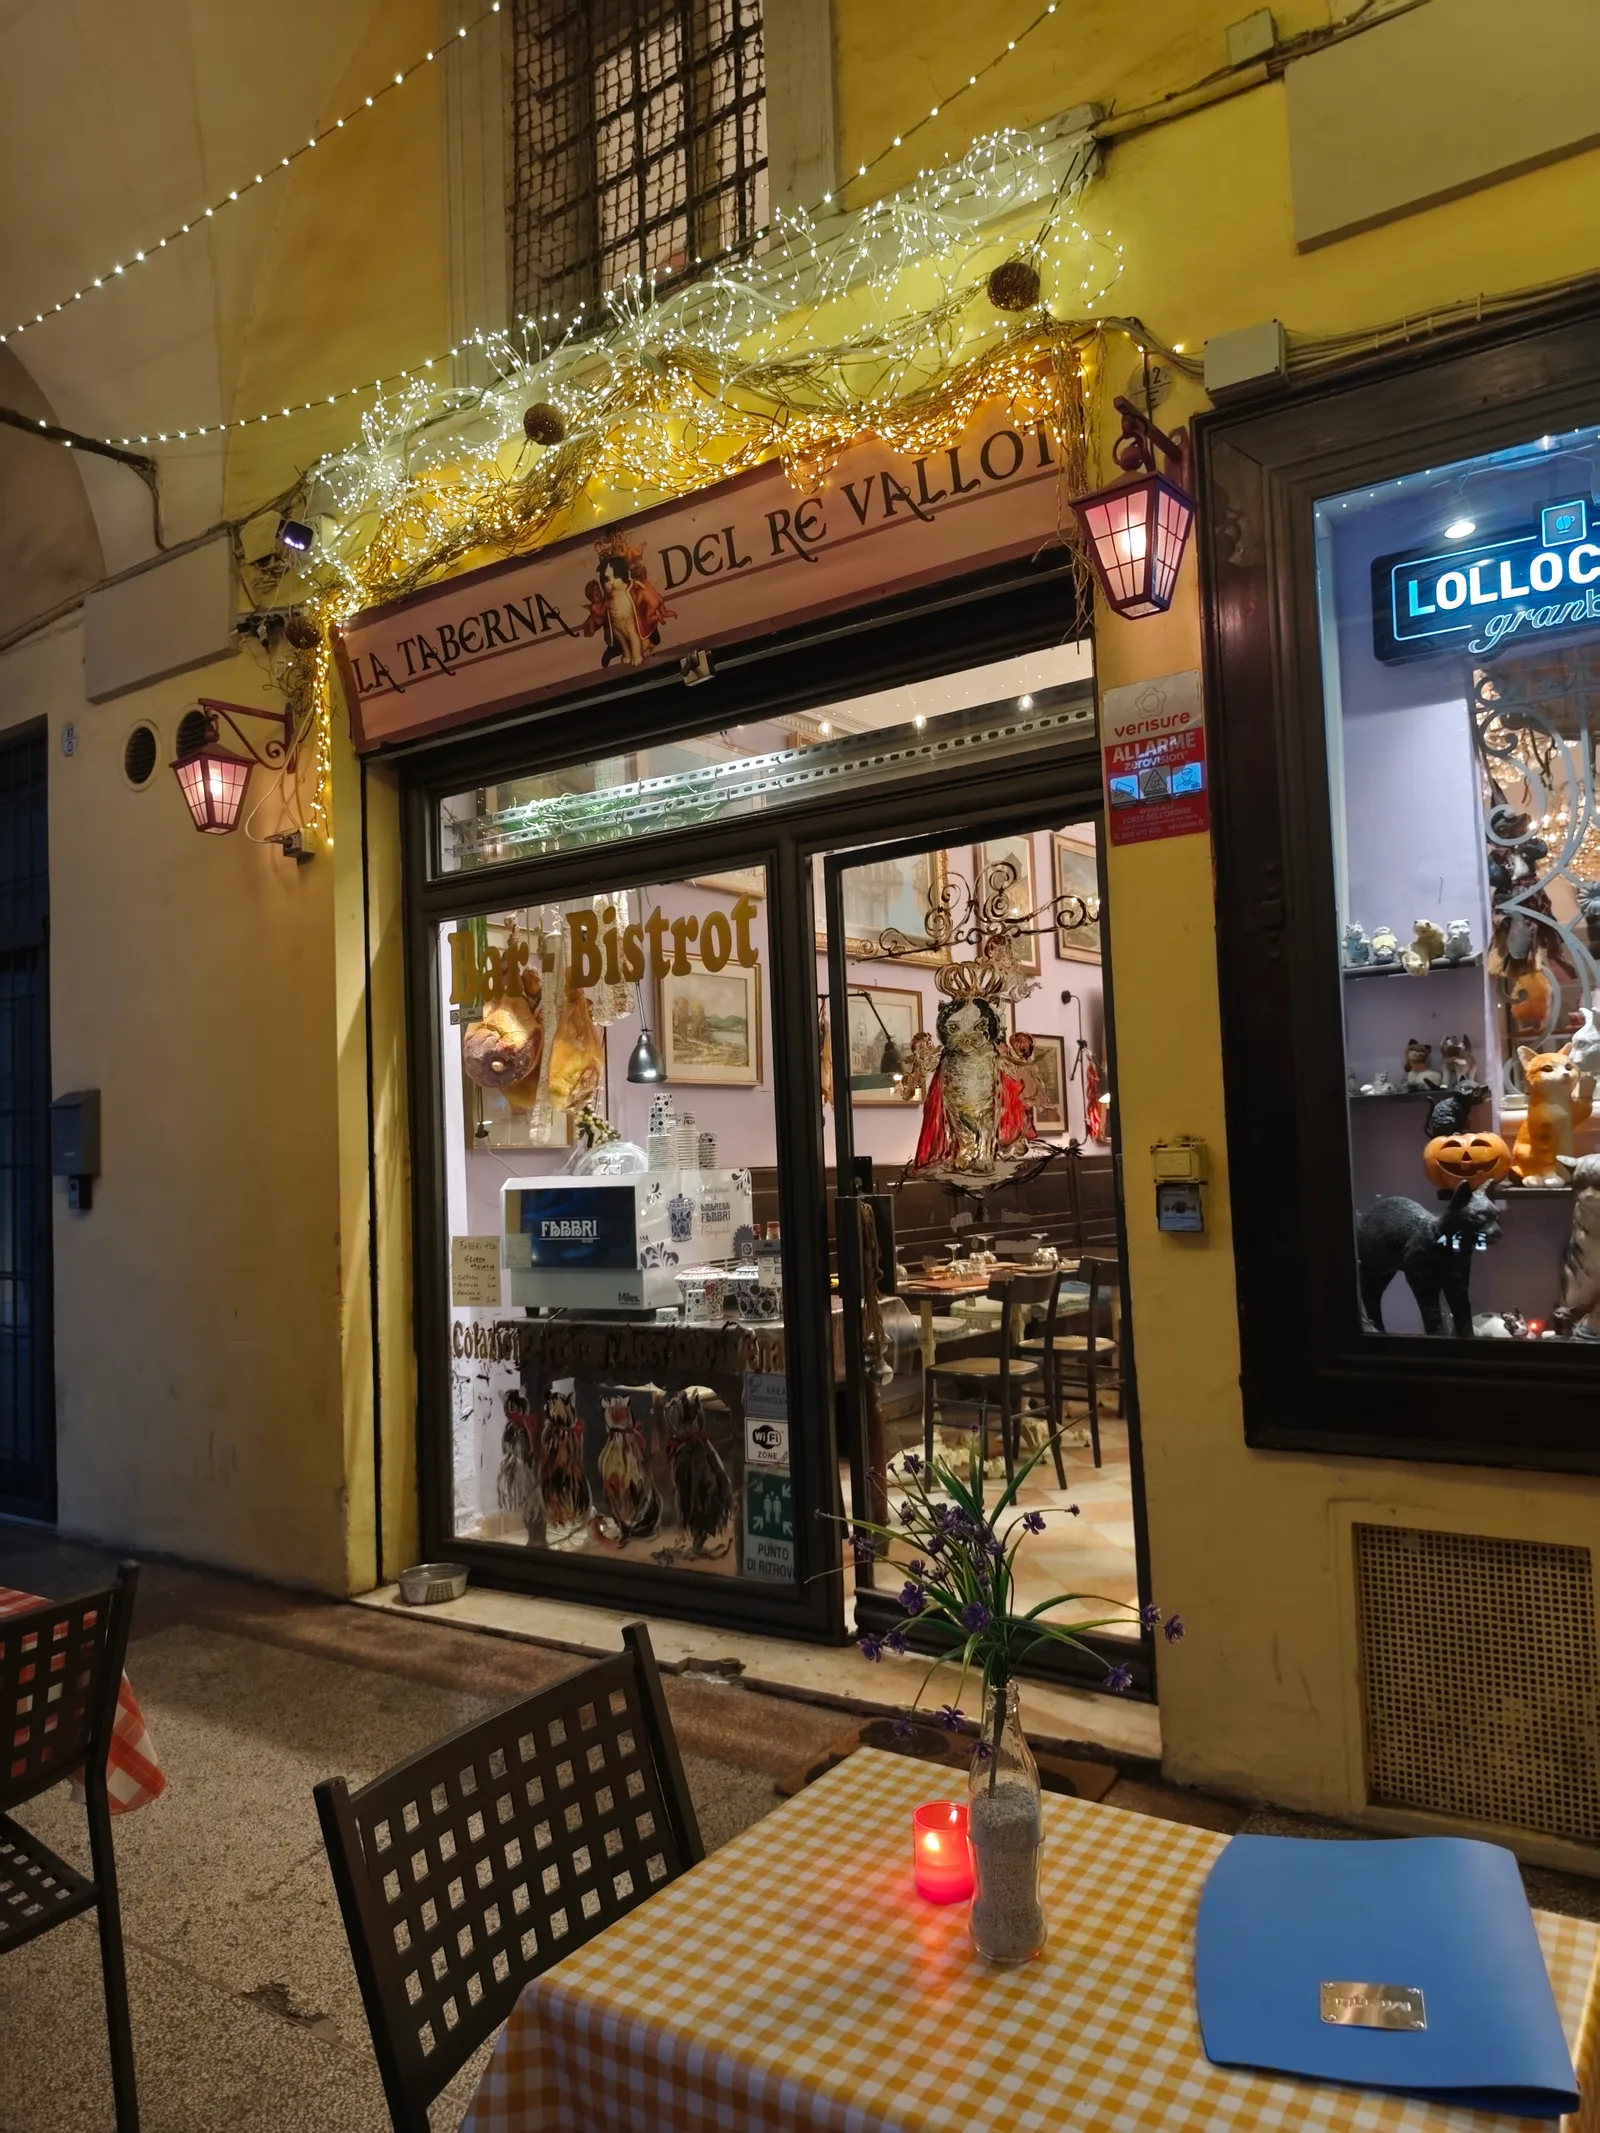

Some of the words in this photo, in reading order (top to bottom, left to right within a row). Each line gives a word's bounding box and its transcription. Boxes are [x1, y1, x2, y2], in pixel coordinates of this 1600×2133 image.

[351, 653, 405, 694] LA
[396, 593, 580, 676] TABERNA
[658, 526, 752, 590] DEL
[764, 498, 827, 562] RE
[840, 418, 1056, 523] VALLOT
[1408, 543, 1600, 617] LOLLOC
[1114, 712, 1191, 738] verisure
[1112, 731, 1197, 764] ALLARME
[448, 931, 530, 1005] Bar
[566, 891, 759, 988] Bistrot
[700, 1210, 731, 1223] FABBRI
[541, 1220, 598, 1237] FABBRI
[766, 1385, 787, 1396] AREA
[757, 1451, 778, 1460] ZONE
[757, 1543, 790, 1561] PUNTO
[746, 1558, 757, 1572] DI
[758, 1560, 796, 1579] RITROV
